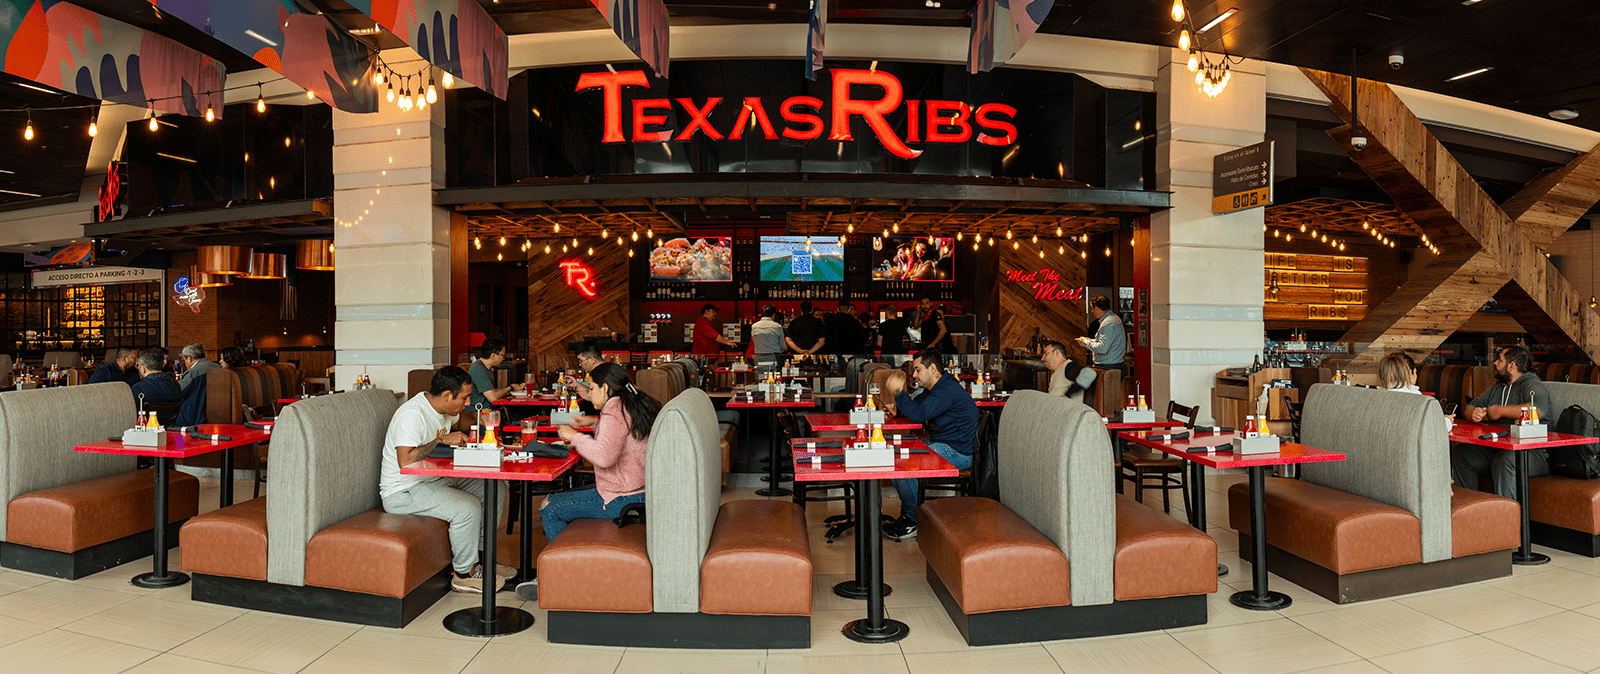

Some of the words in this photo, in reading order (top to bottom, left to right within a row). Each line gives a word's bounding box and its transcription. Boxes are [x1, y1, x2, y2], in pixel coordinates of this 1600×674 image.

[48, 273, 69, 281] ACCESO
[70, 271, 94, 280] DIRECTO
[100, 269, 126, 278] PARKING
[1005, 269, 1038, 282] Meet
[1039, 268, 1061, 282] The
[1271, 271, 1328, 285] BETTER
[1031, 281, 1084, 301] Meat
[1336, 292, 1362, 302] YOU
[1310, 306, 1346, 318] RIBS
